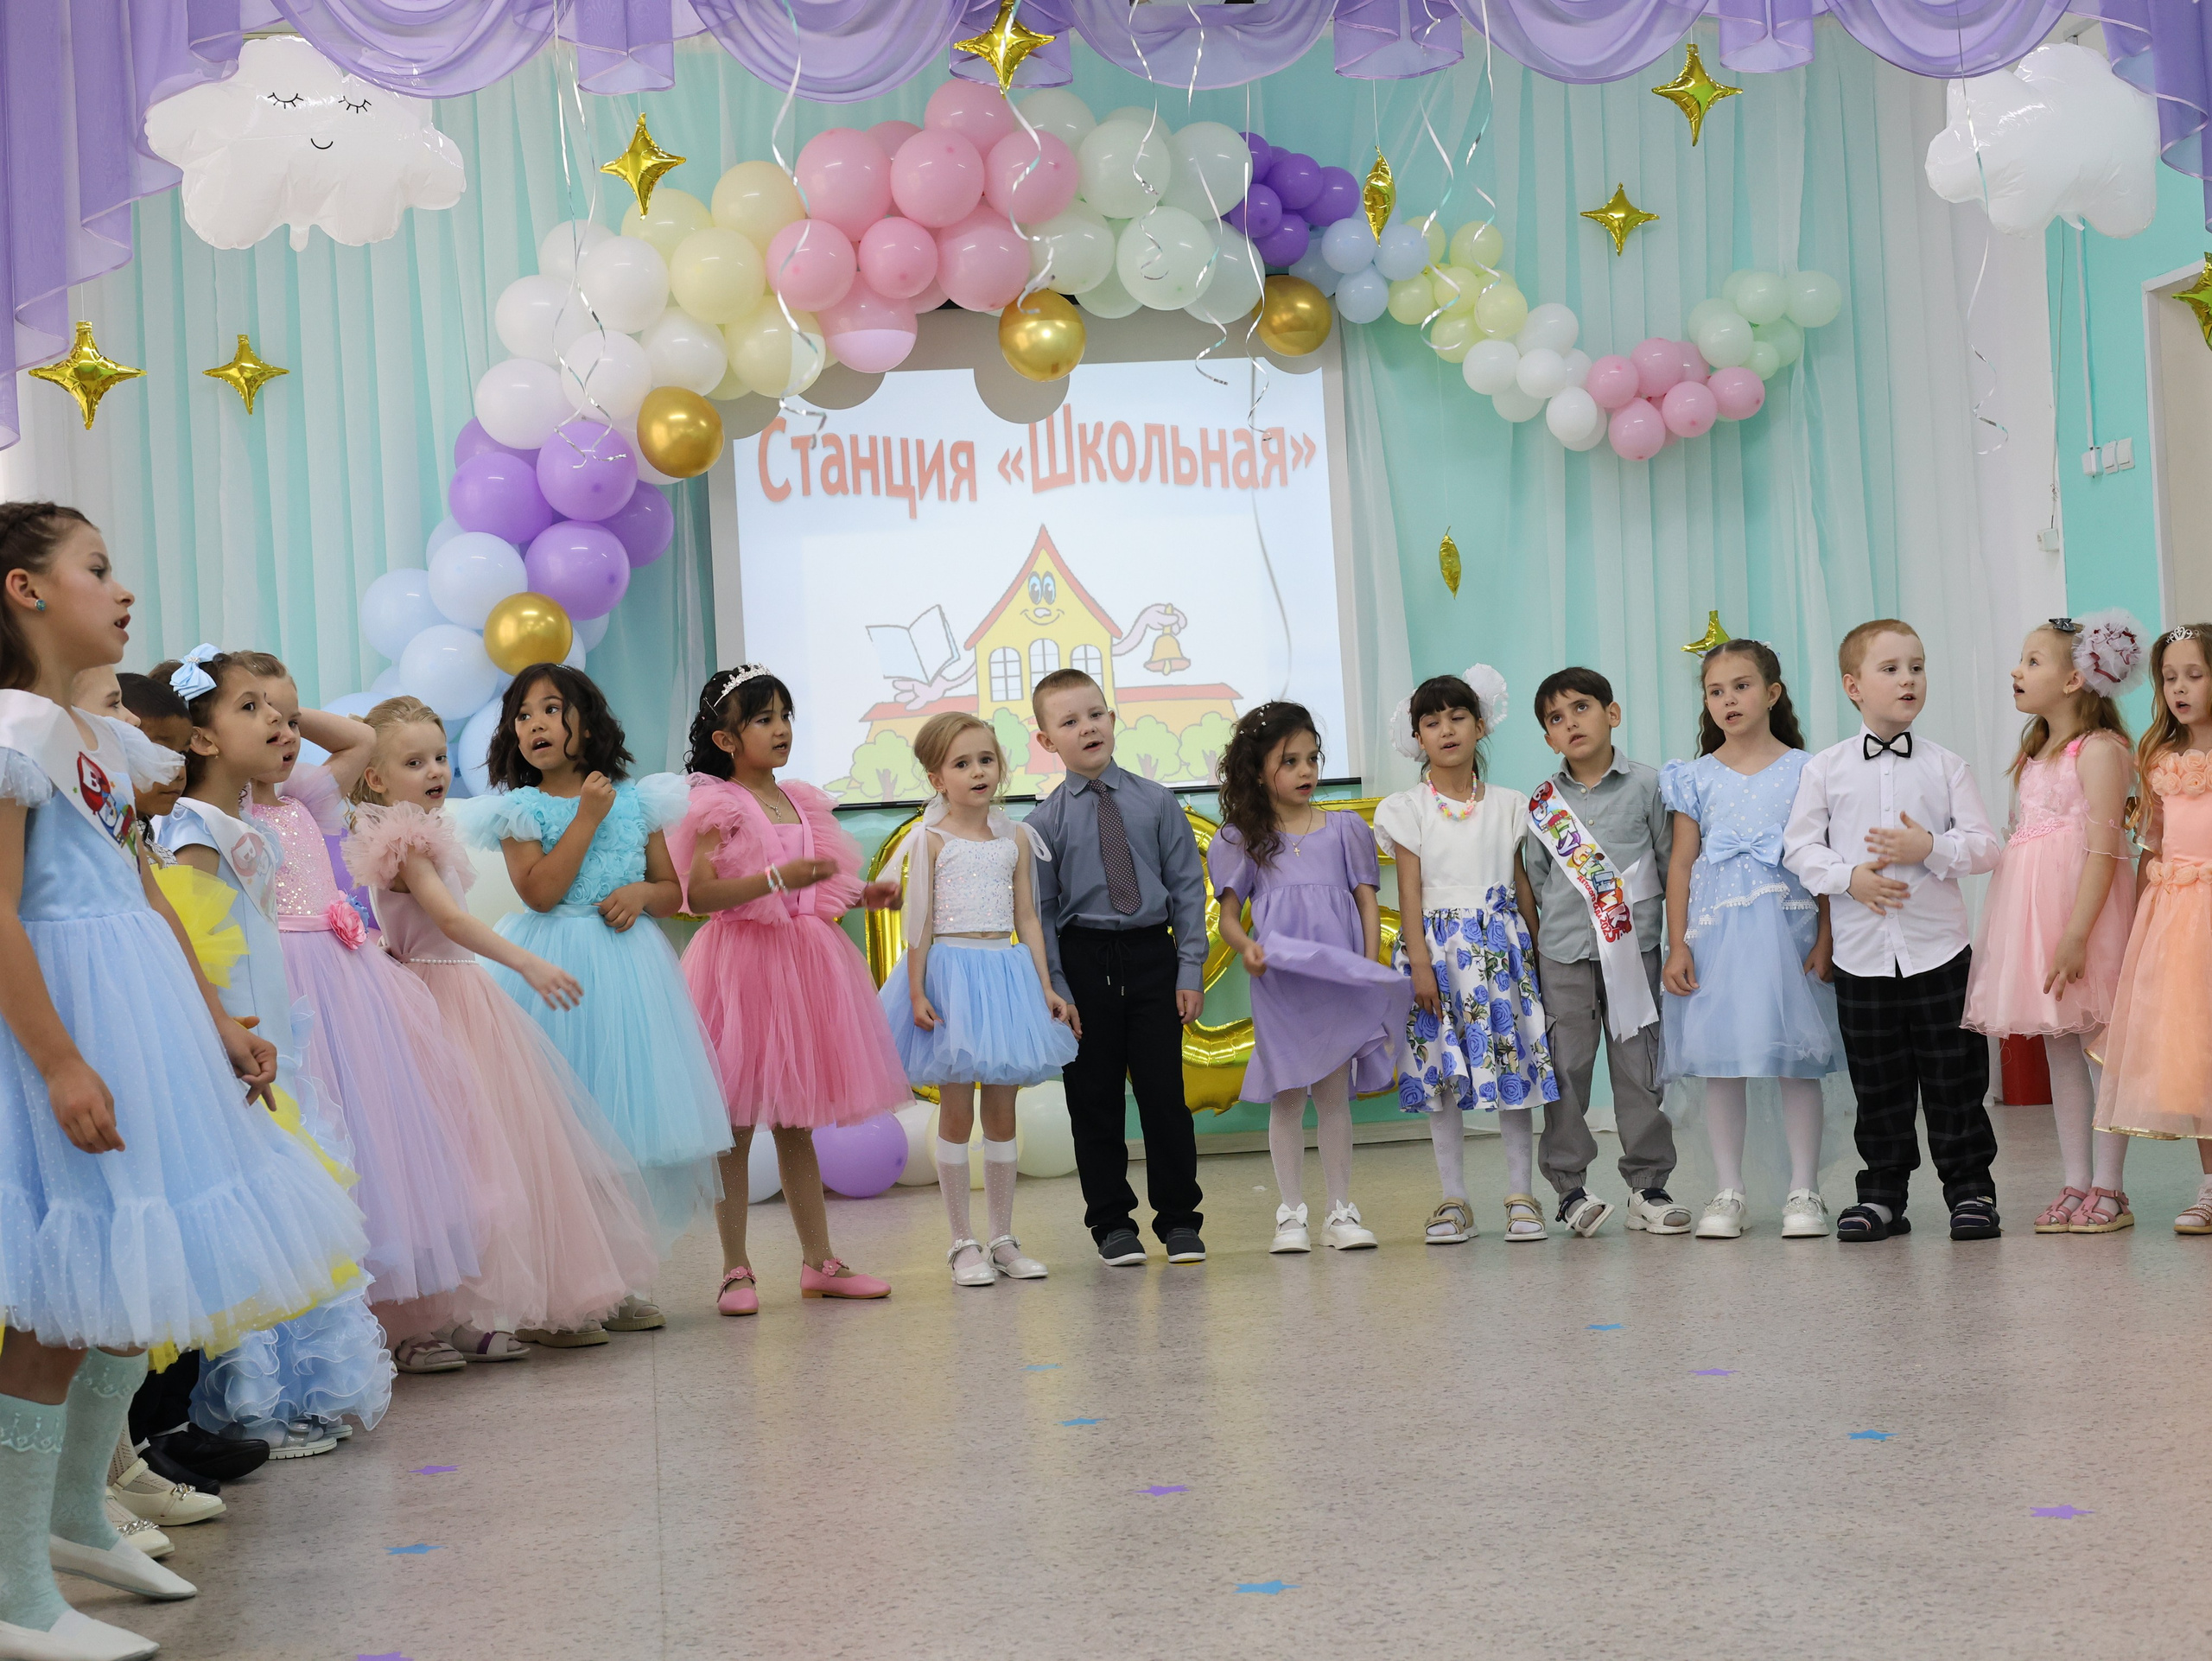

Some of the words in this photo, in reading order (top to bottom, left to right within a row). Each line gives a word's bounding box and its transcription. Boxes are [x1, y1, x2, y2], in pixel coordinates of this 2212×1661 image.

[758, 416, 977, 519] Станция
[998, 403, 1316, 493] «Школьная»
[1530, 781, 1628, 930] ВЫПУСКНИК
[1577, 875, 1597, 902] ДЕТСКОГО
[1599, 917, 1621, 943] 2025
